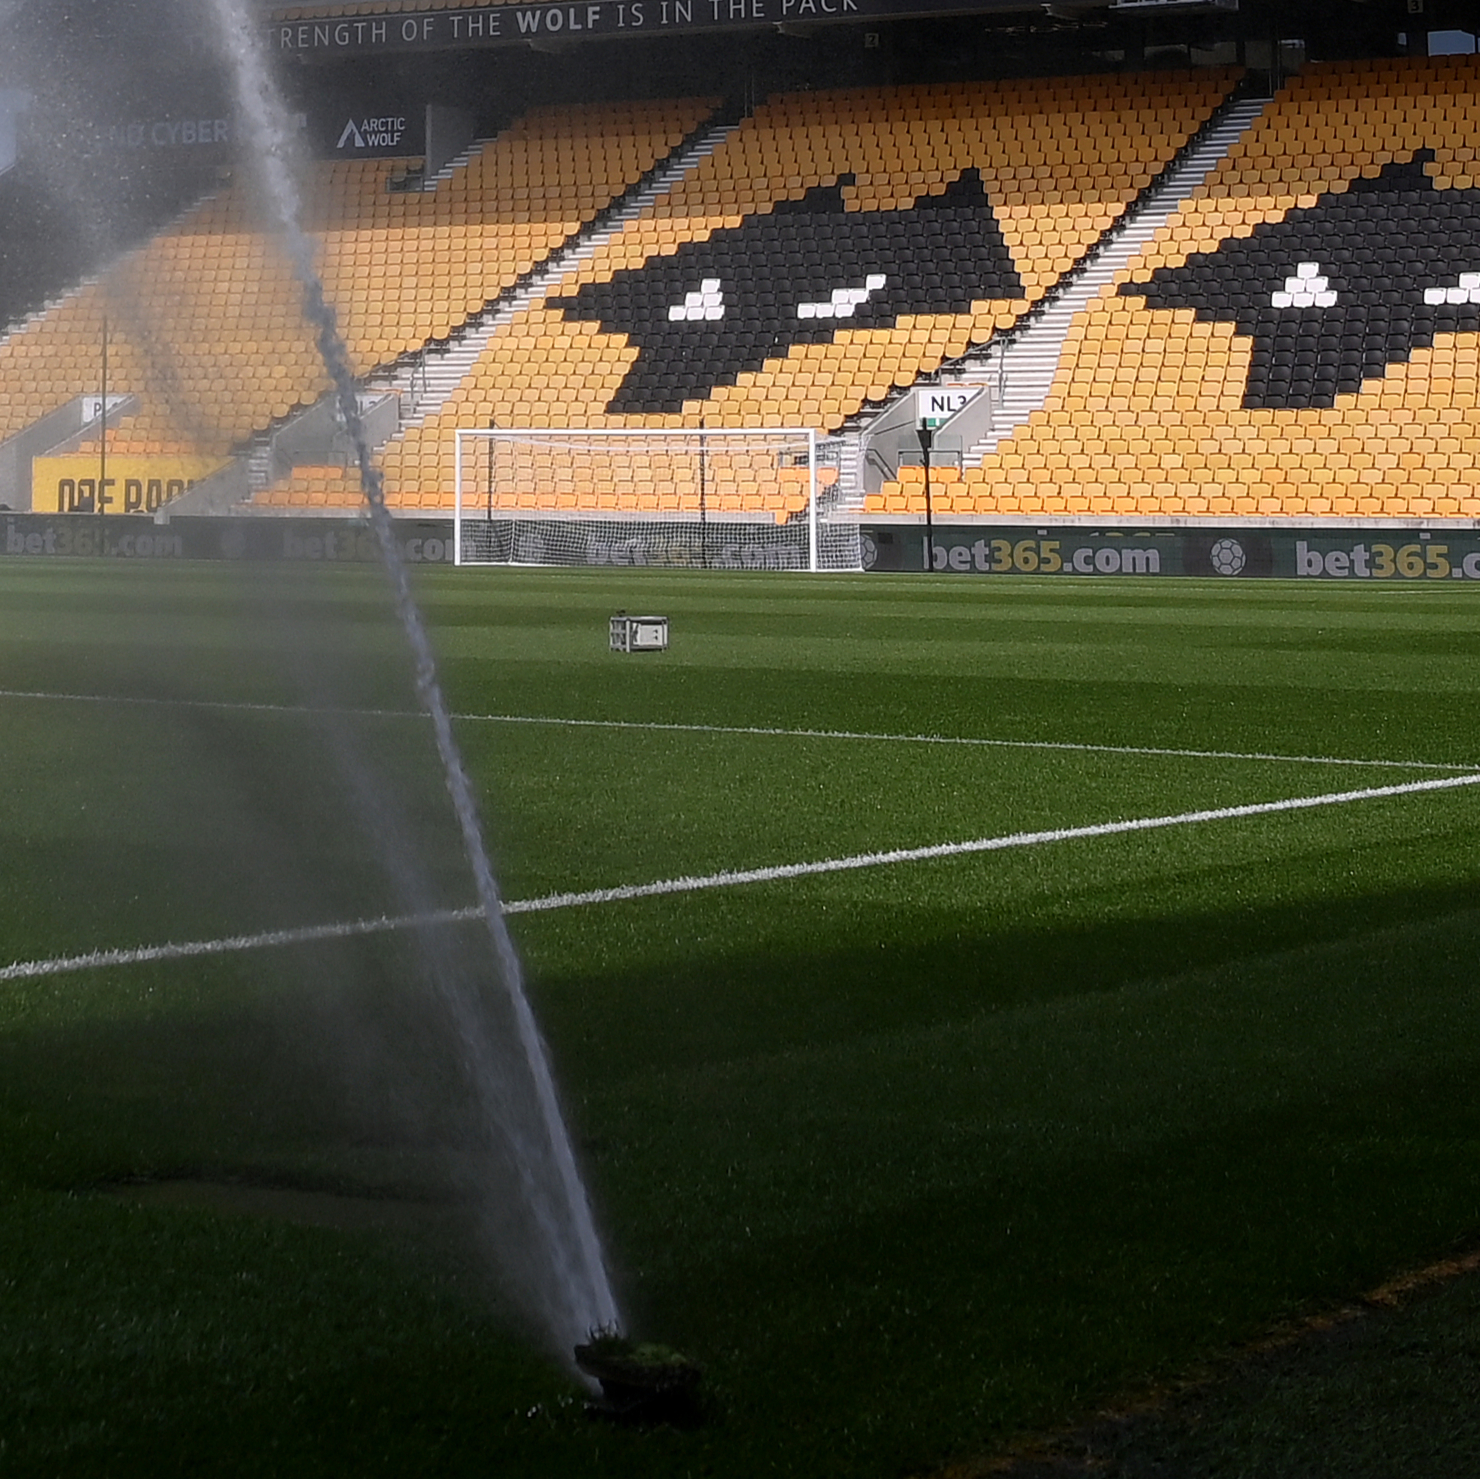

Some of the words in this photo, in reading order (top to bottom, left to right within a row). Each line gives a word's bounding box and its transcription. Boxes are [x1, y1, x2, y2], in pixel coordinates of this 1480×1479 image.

[402, 16, 434, 42] OF
[448, 13, 502, 40] THE
[515, 6, 602, 33] WOLF
[617, 4, 644, 28] IS
[660, 0, 693, 25] IN
[151, 118, 229, 146] CYBER
[360, 116, 406, 132] ARCTIC
[366, 131, 402, 147] WOLF
[6, 524, 183, 558] bet365.com
[923, 535, 1161, 574] bet365.com
